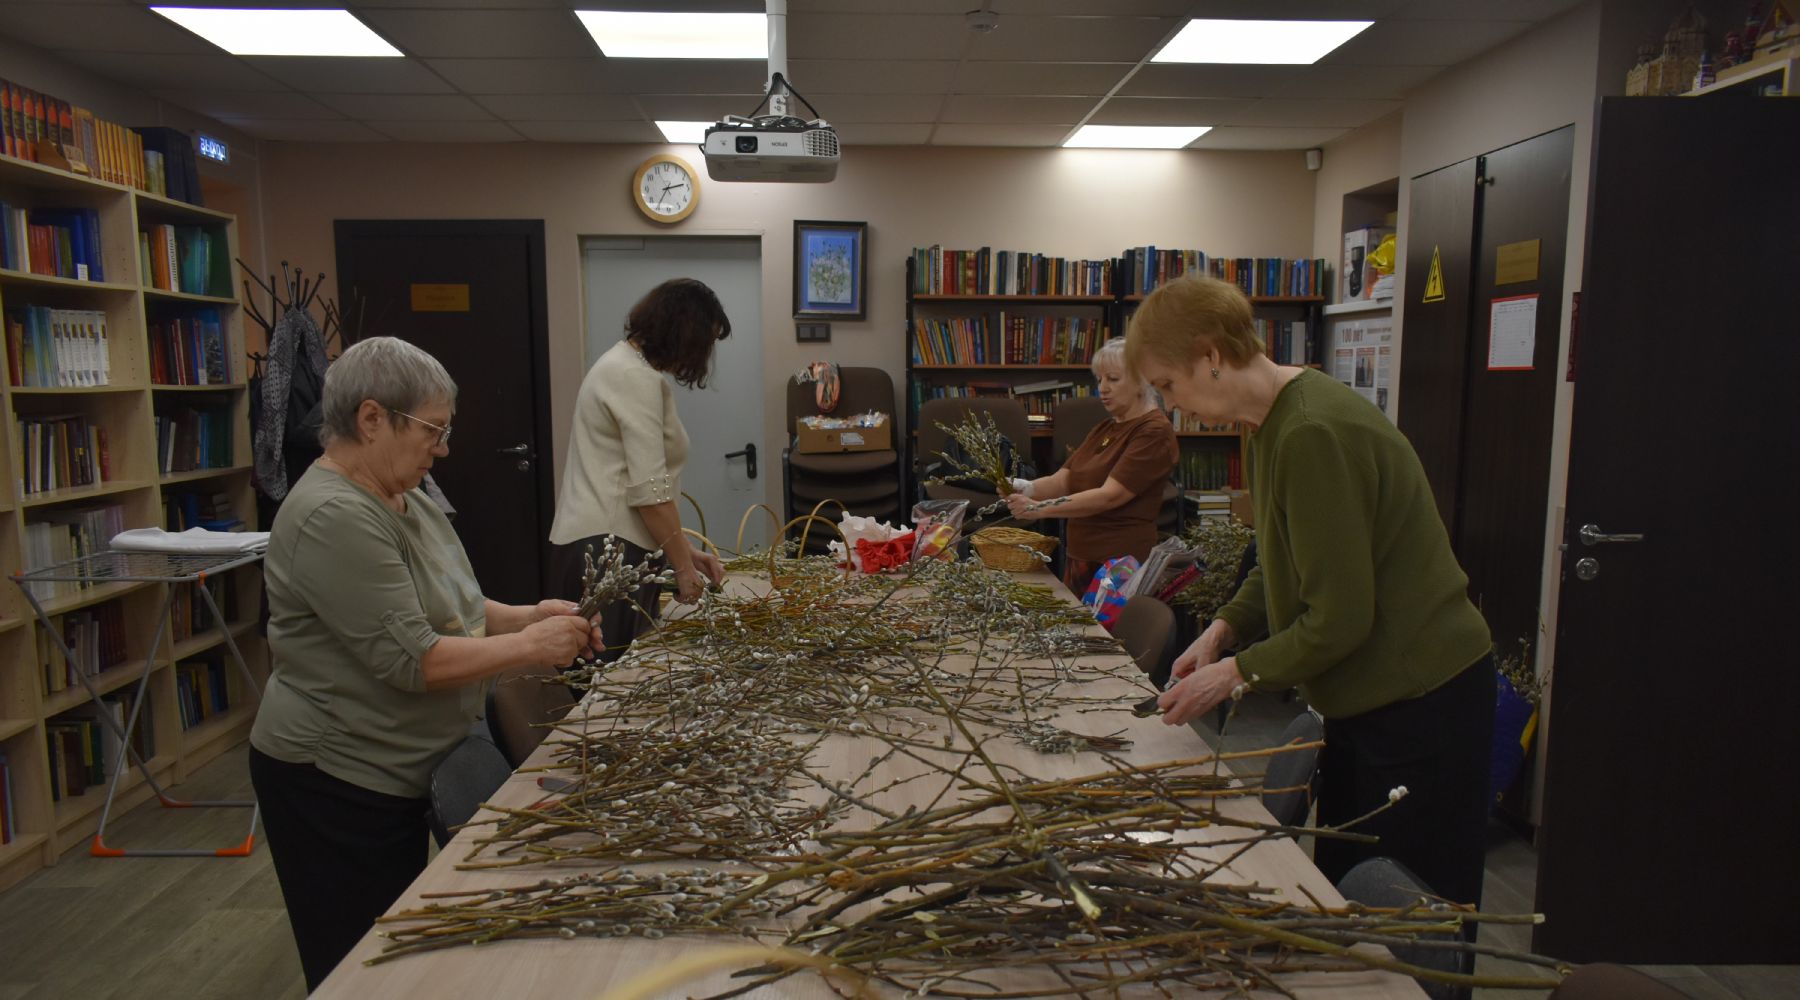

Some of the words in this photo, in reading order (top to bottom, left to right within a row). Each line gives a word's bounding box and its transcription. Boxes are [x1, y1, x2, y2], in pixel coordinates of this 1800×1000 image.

[199, 137, 226, 158] ВЫХОД
[654, 166, 660, 175] 11
[663, 164, 669, 172] 12
